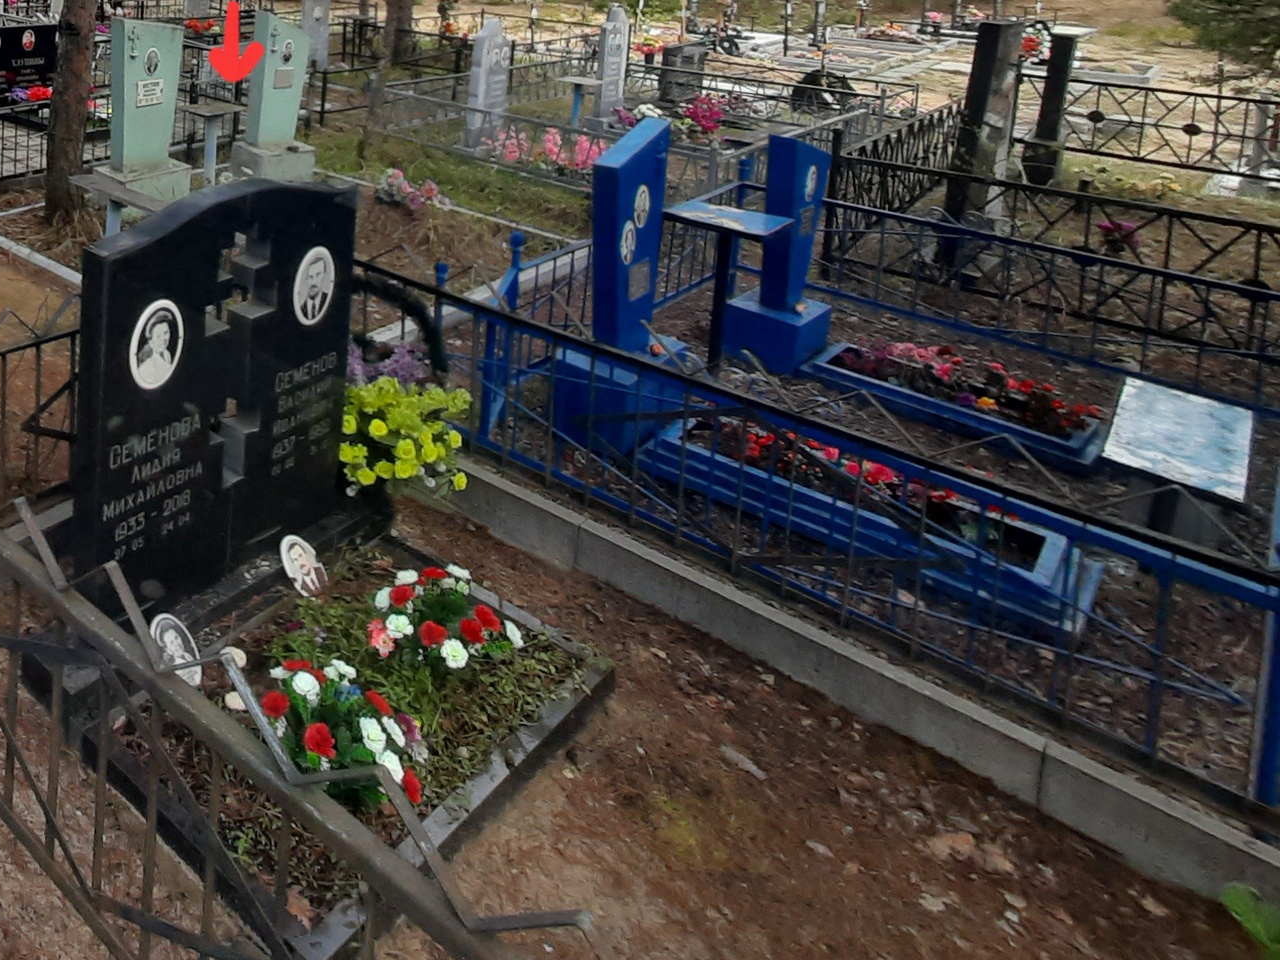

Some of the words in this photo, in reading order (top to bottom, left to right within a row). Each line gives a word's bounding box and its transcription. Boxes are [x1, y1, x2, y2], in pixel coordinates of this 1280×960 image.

[102, 461, 203, 522] МИХАЙЛОВНА
[131, 448, 181, 484] ЛИДИЯ
[115, 511, 146, 542] 1933
[163, 489, 191, 517] 2018
